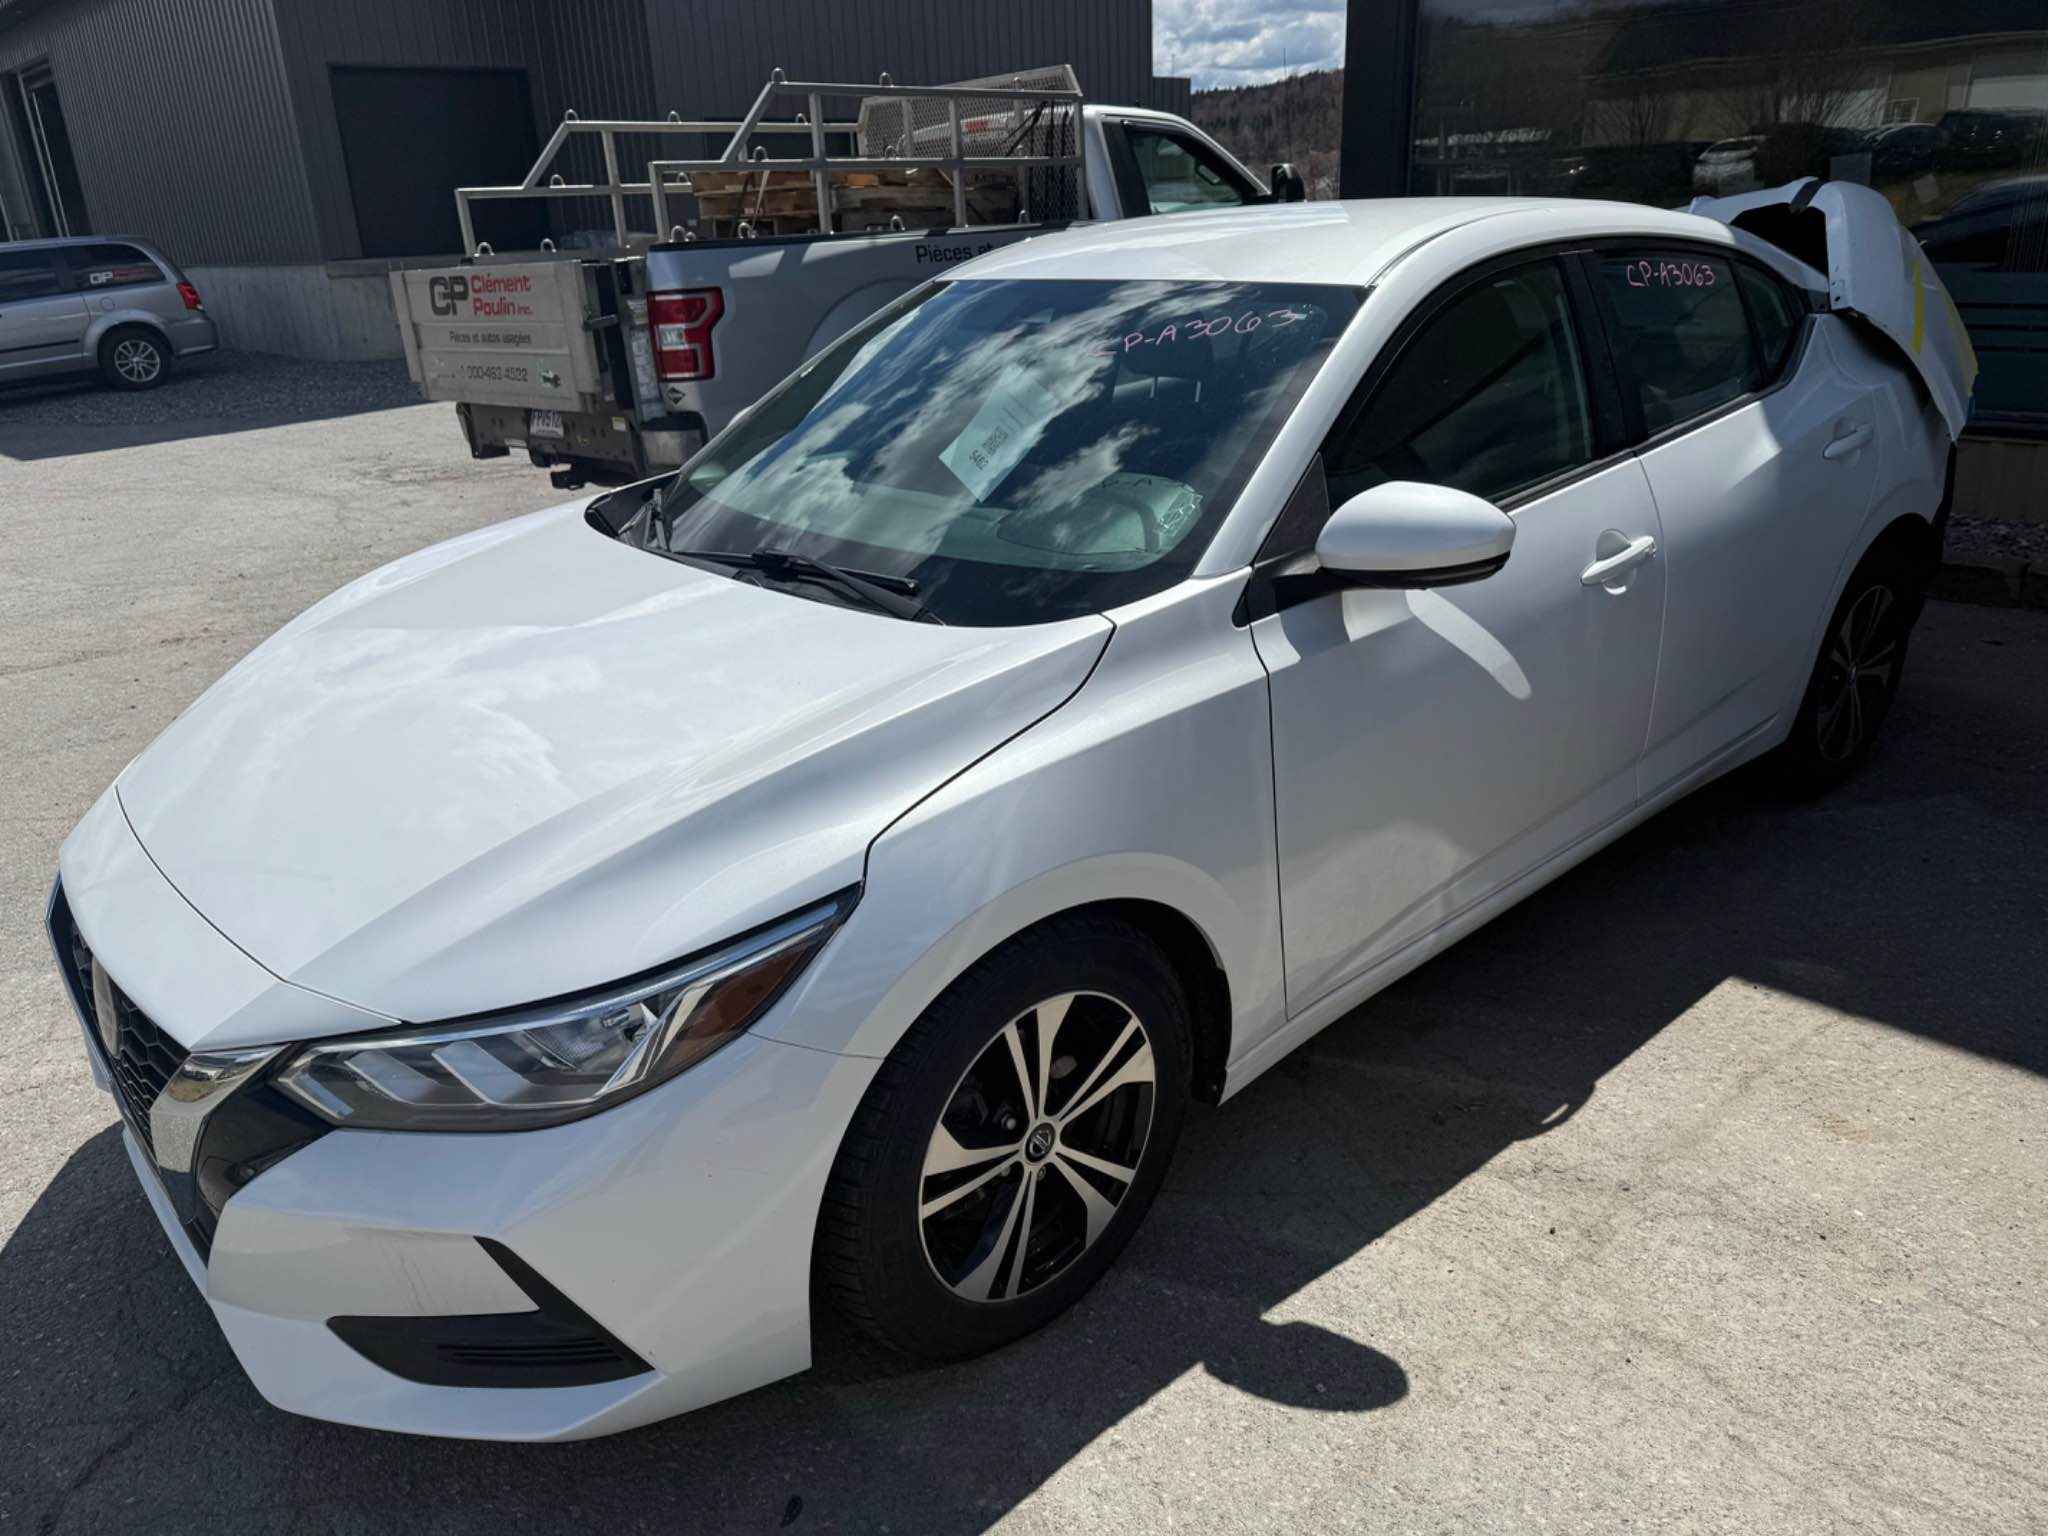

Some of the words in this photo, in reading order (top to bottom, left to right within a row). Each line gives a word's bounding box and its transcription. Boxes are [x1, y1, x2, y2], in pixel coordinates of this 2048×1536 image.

[914, 244, 973, 264] Pièces
[470, 274, 532, 293] Clément
[1626, 261, 1716, 287] CP-A3063
[473, 296, 516, 317] Poulin
